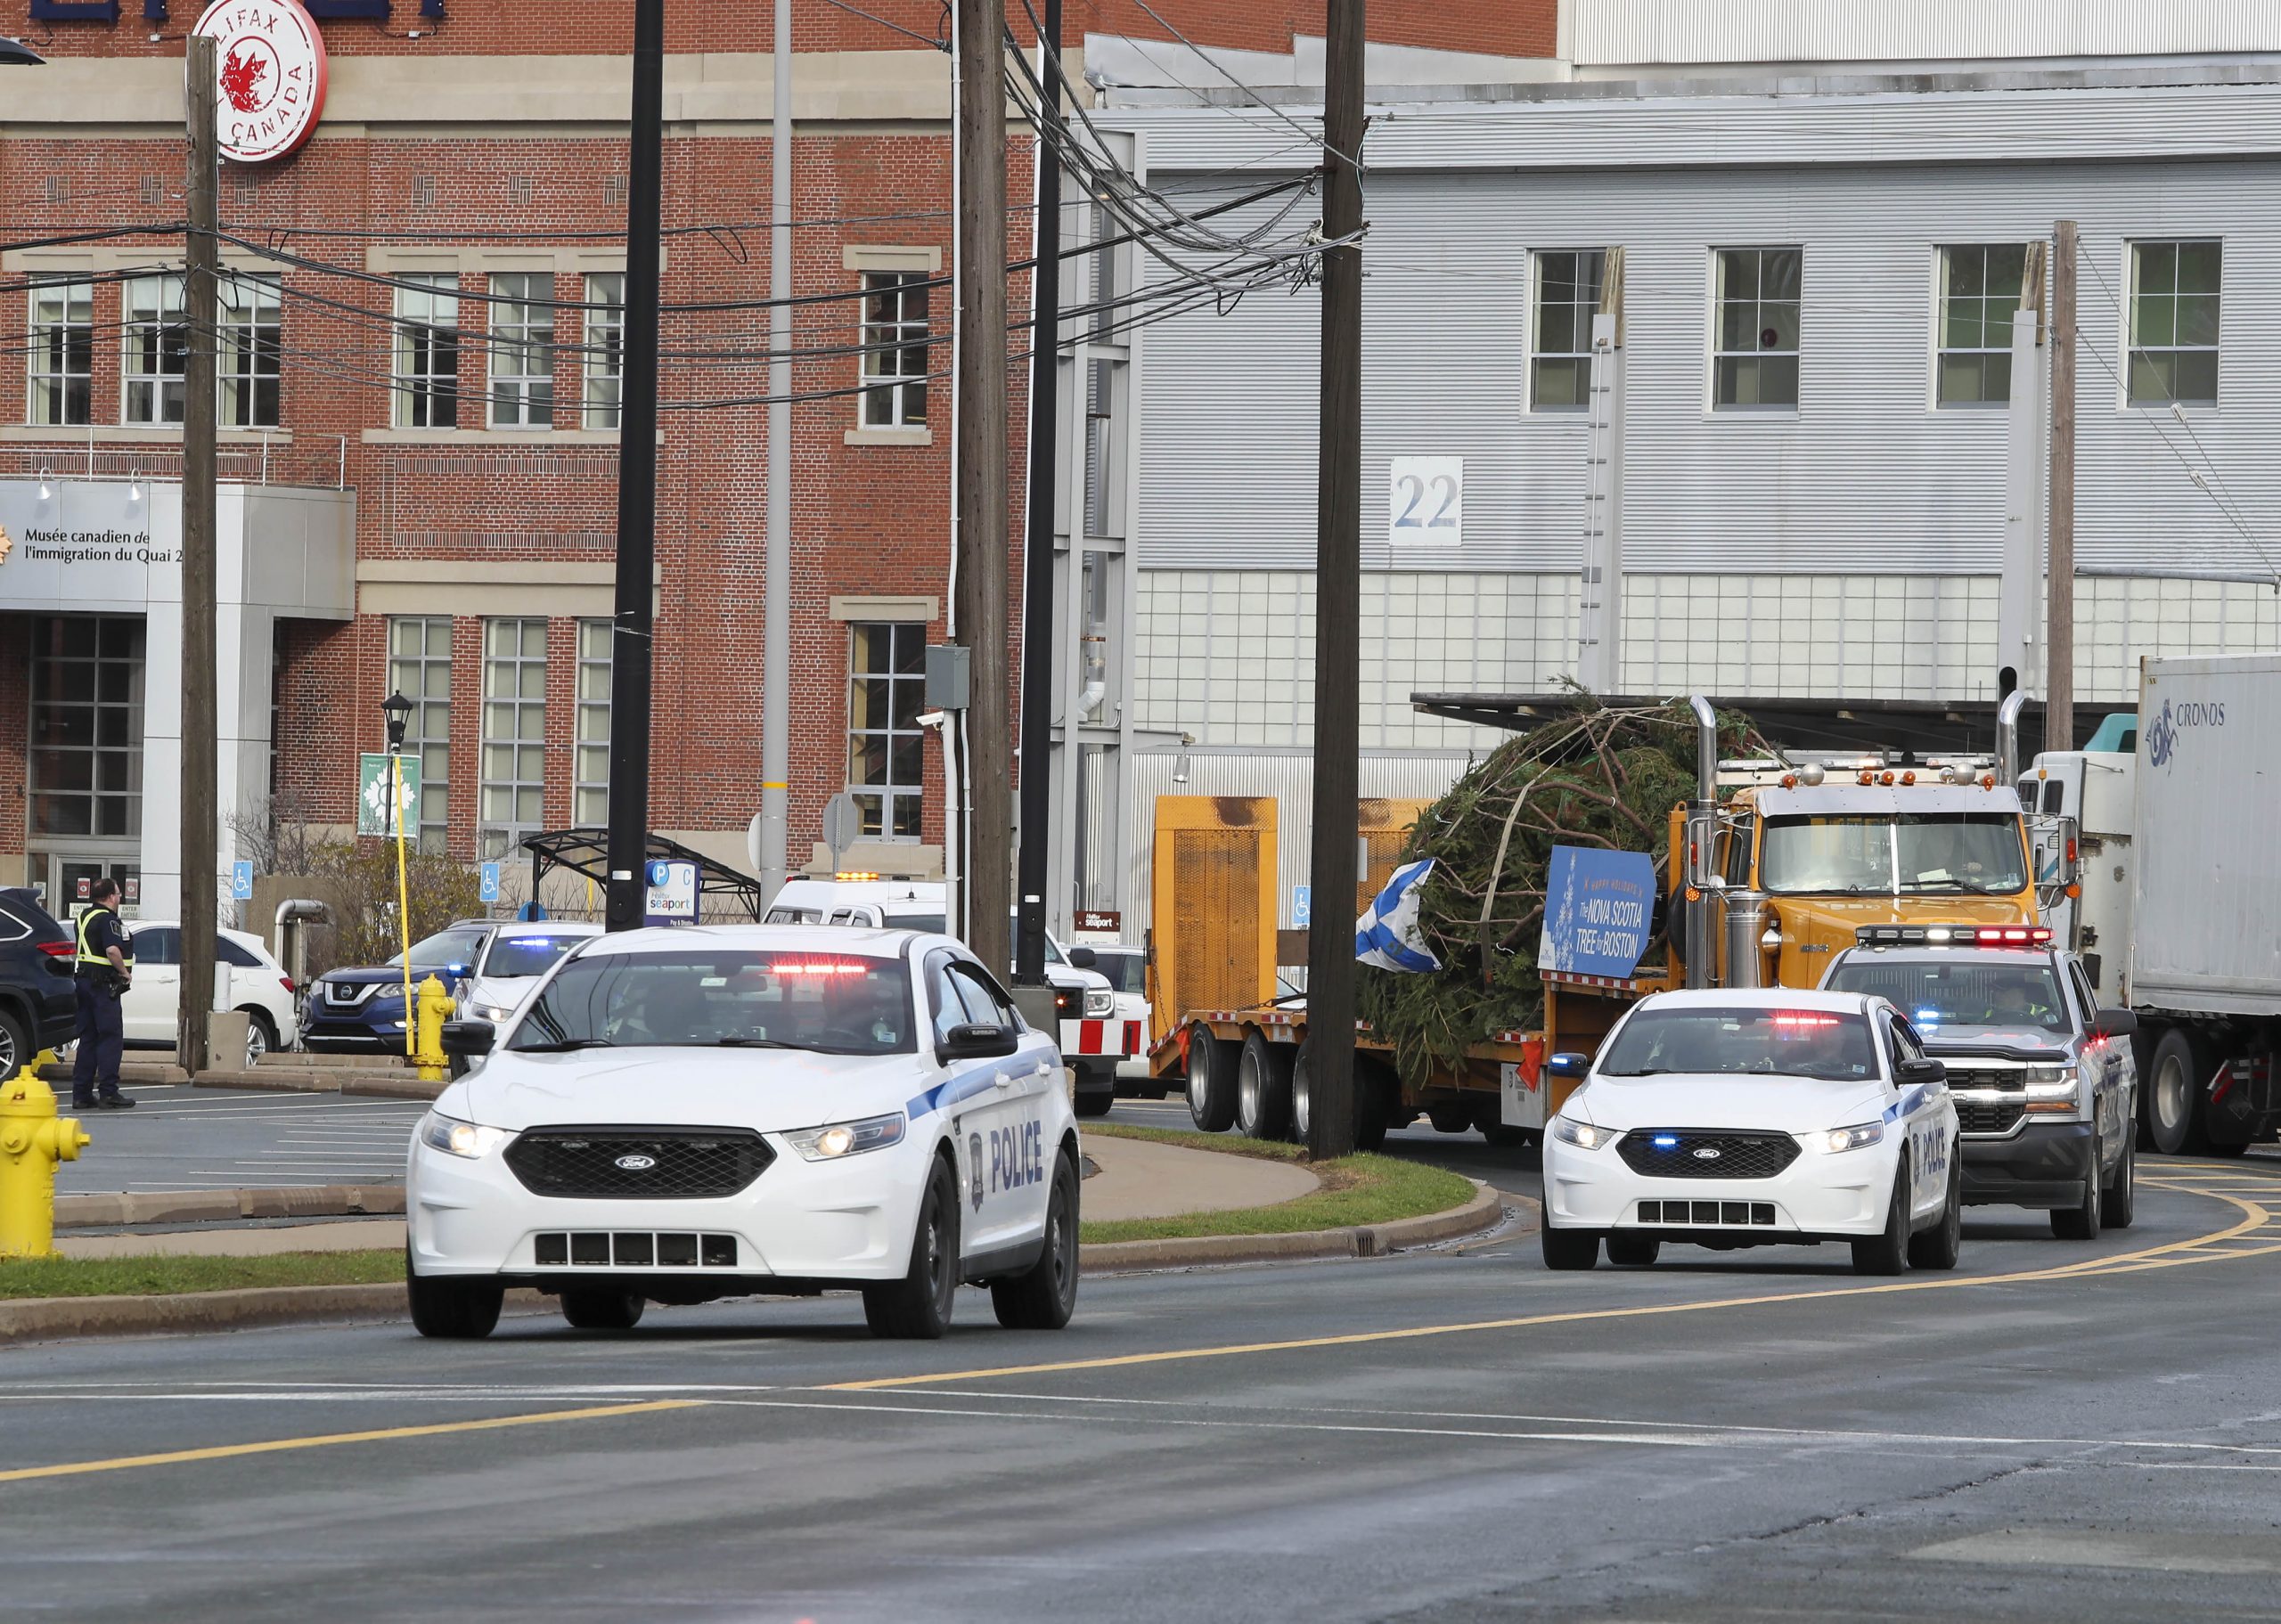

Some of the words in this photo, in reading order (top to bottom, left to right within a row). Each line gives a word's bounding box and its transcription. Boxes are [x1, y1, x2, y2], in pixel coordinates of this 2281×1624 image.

[212, 9, 279, 45] LIFAX
[231, 65, 303, 143] CANADA
[1394, 474, 1458, 528] 22
[25, 528, 68, 543] Musée
[71, 530, 131, 543] canadien
[134, 531, 150, 544] de
[25, 545, 110, 565] l'immigration
[115, 547, 132, 561] du
[136, 549, 171, 564] Quai
[175, 551, 183, 563] 2
[2177, 702, 2225, 727] CRONOS
[656, 865, 666, 882] P
[683, 869, 691, 885] C
[650, 898, 691, 911] seaport
[1587, 898, 1610, 926] NOVA
[1611, 901, 1643, 928] SCOTIA
[1085, 918, 1113, 929] seaport
[1576, 928, 1598, 955] TREE
[1596, 934, 1605, 951] for
[1602, 931, 1639, 959] BOSTON
[991, 1120, 1042, 1193] POLICE
[1923, 1127, 1946, 1177] POLICE
